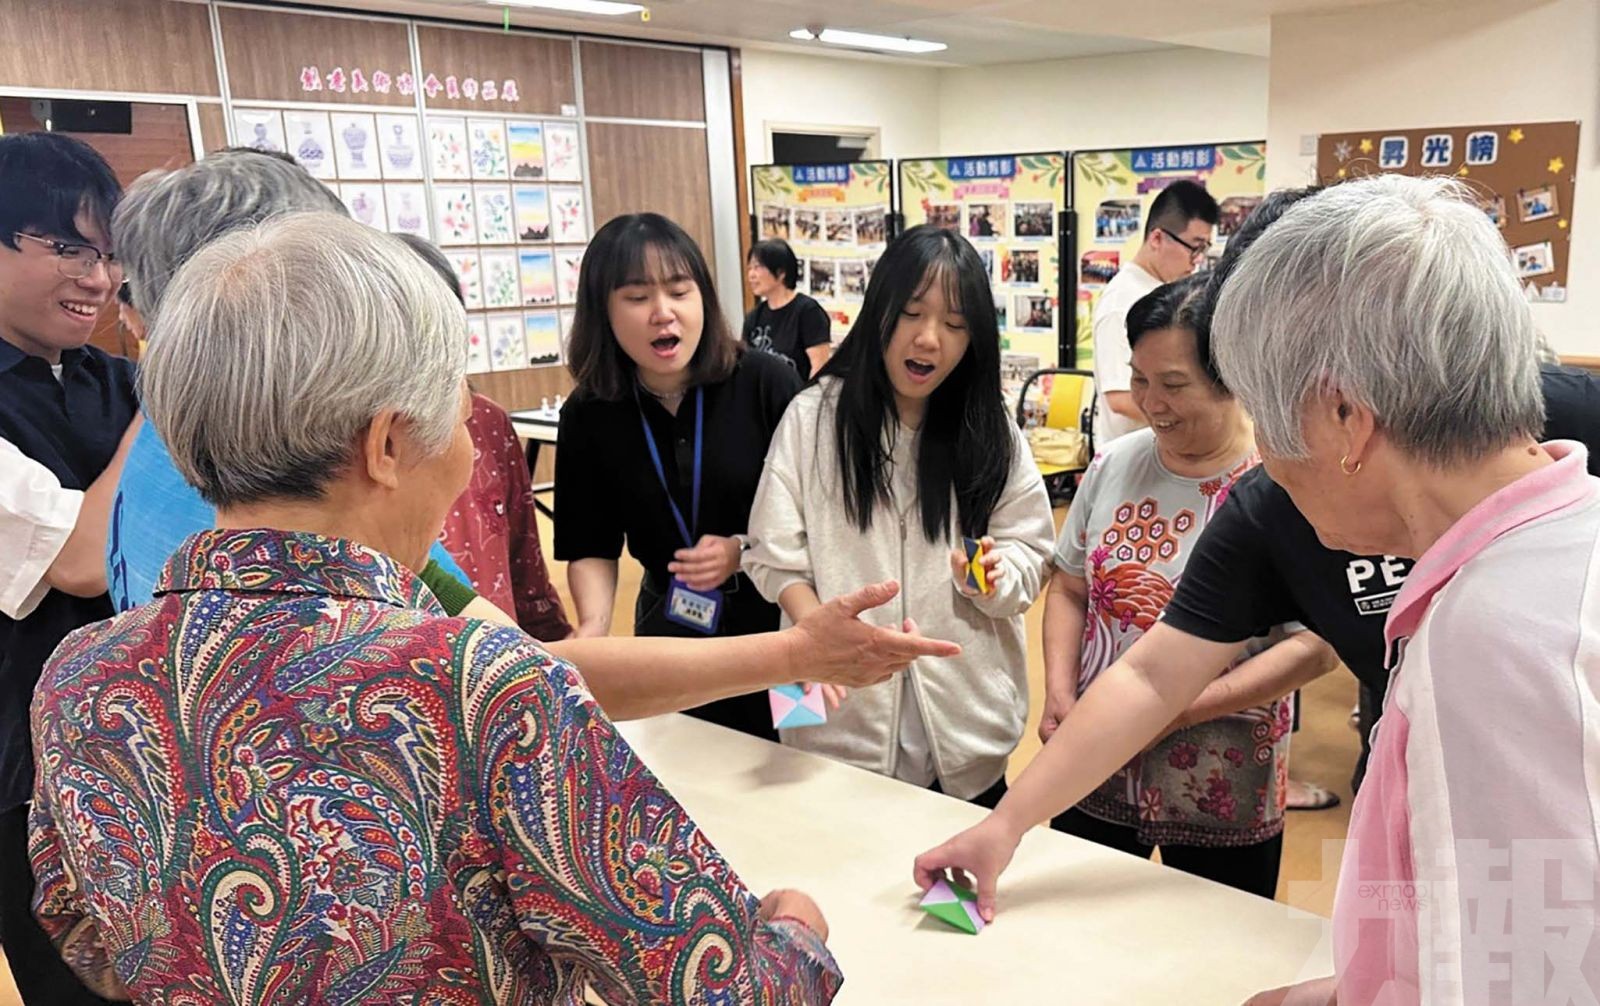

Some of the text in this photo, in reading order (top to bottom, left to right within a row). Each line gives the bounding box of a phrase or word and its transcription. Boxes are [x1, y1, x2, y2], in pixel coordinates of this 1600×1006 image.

[963, 158, 1012, 176] 活動剪影
[1151, 148, 1211, 169] 活動剪影
[806, 166, 847, 182] 活動剪影
